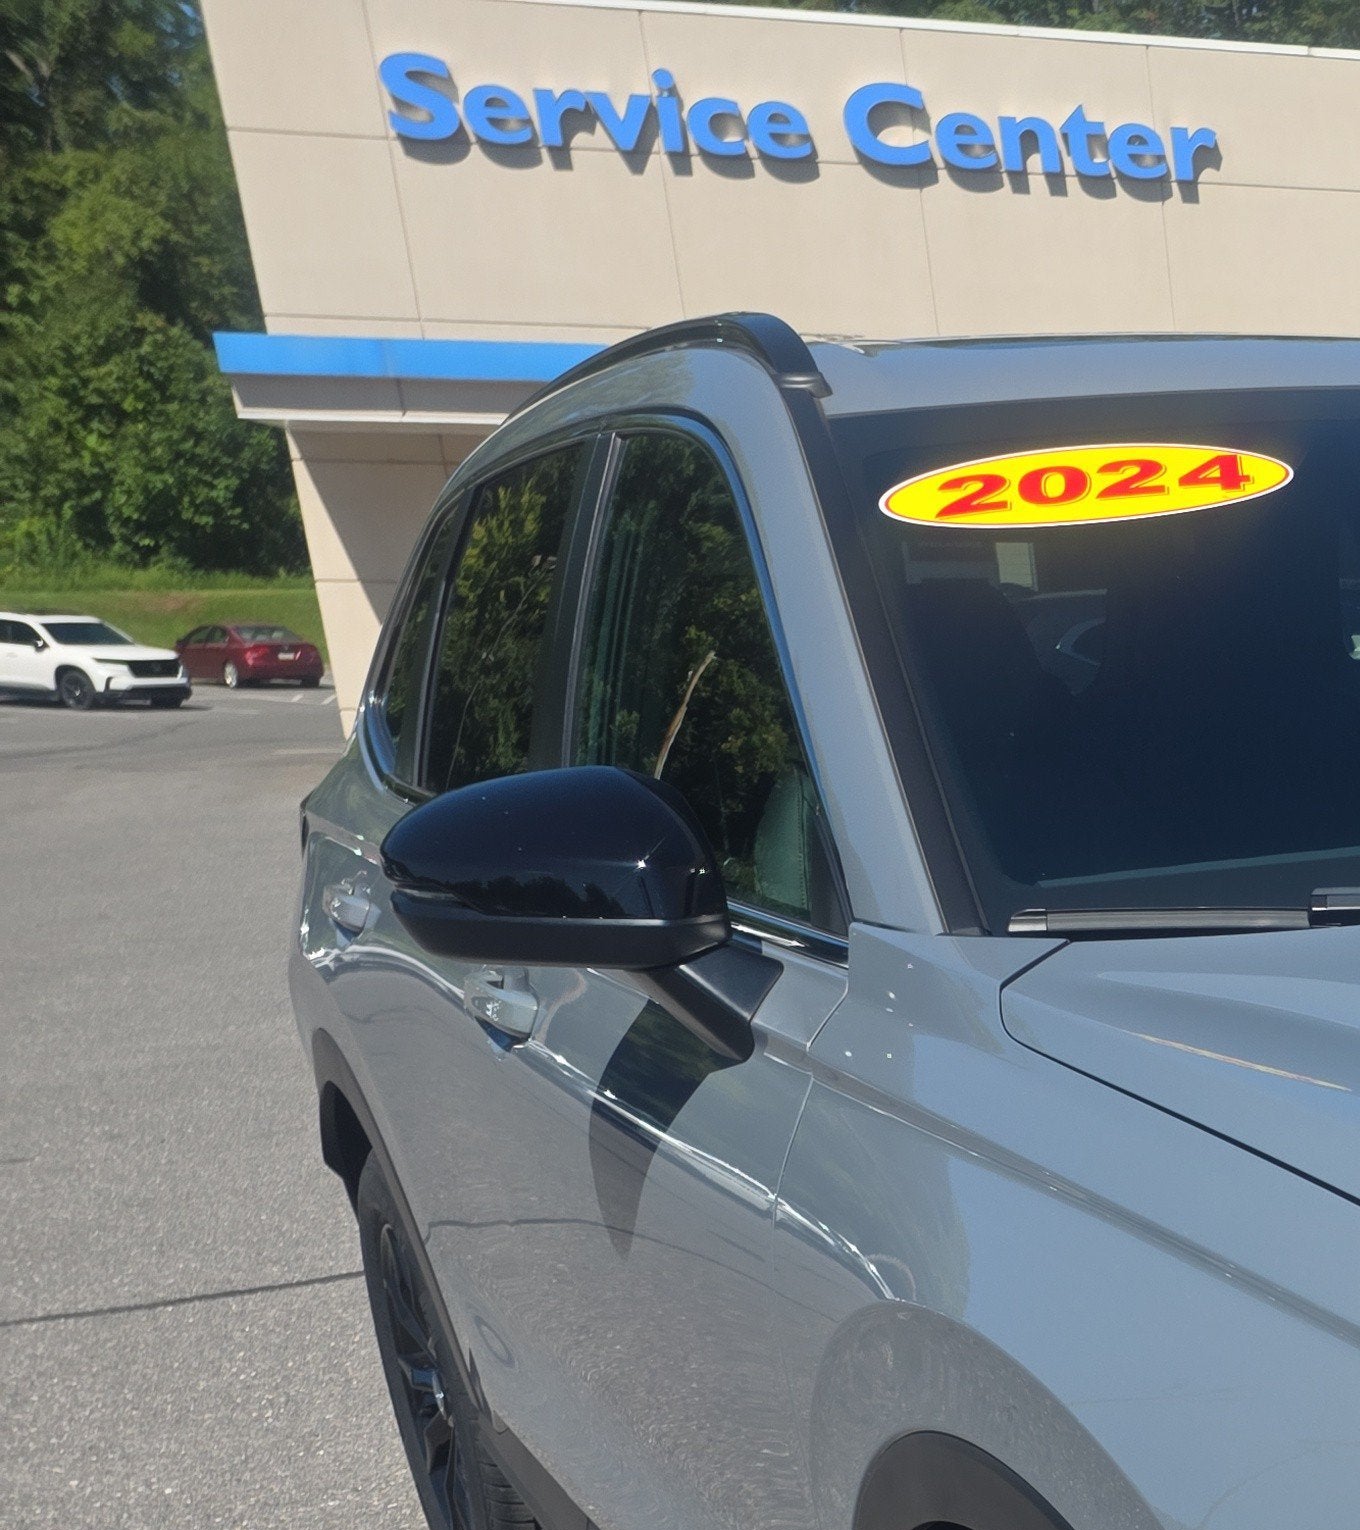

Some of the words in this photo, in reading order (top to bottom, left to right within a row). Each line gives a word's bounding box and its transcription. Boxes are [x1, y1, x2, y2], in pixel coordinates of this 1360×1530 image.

[379, 52, 814, 158] Service
[843, 82, 1217, 184] Center
[935, 454, 1253, 518] 2024
